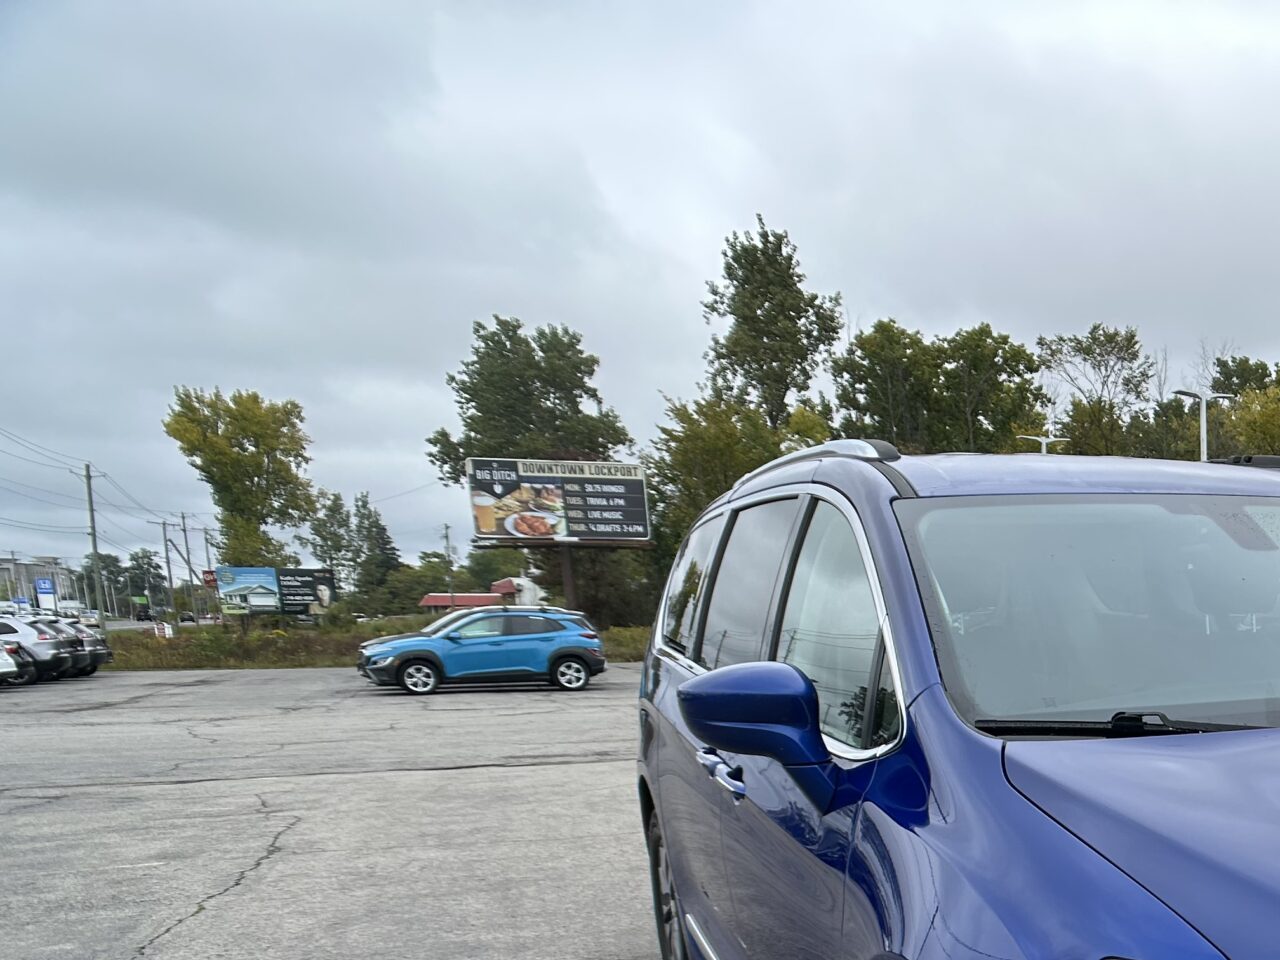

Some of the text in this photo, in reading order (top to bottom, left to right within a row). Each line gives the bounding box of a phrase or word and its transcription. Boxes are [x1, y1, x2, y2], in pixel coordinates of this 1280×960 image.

[476, 469, 517, 481] BIG DITCH
[522, 463, 639, 477] DOWNTOWN LOCKPORT
[587, 511, 601, 519] LIVE
[602, 511, 624, 519] MUSIC
